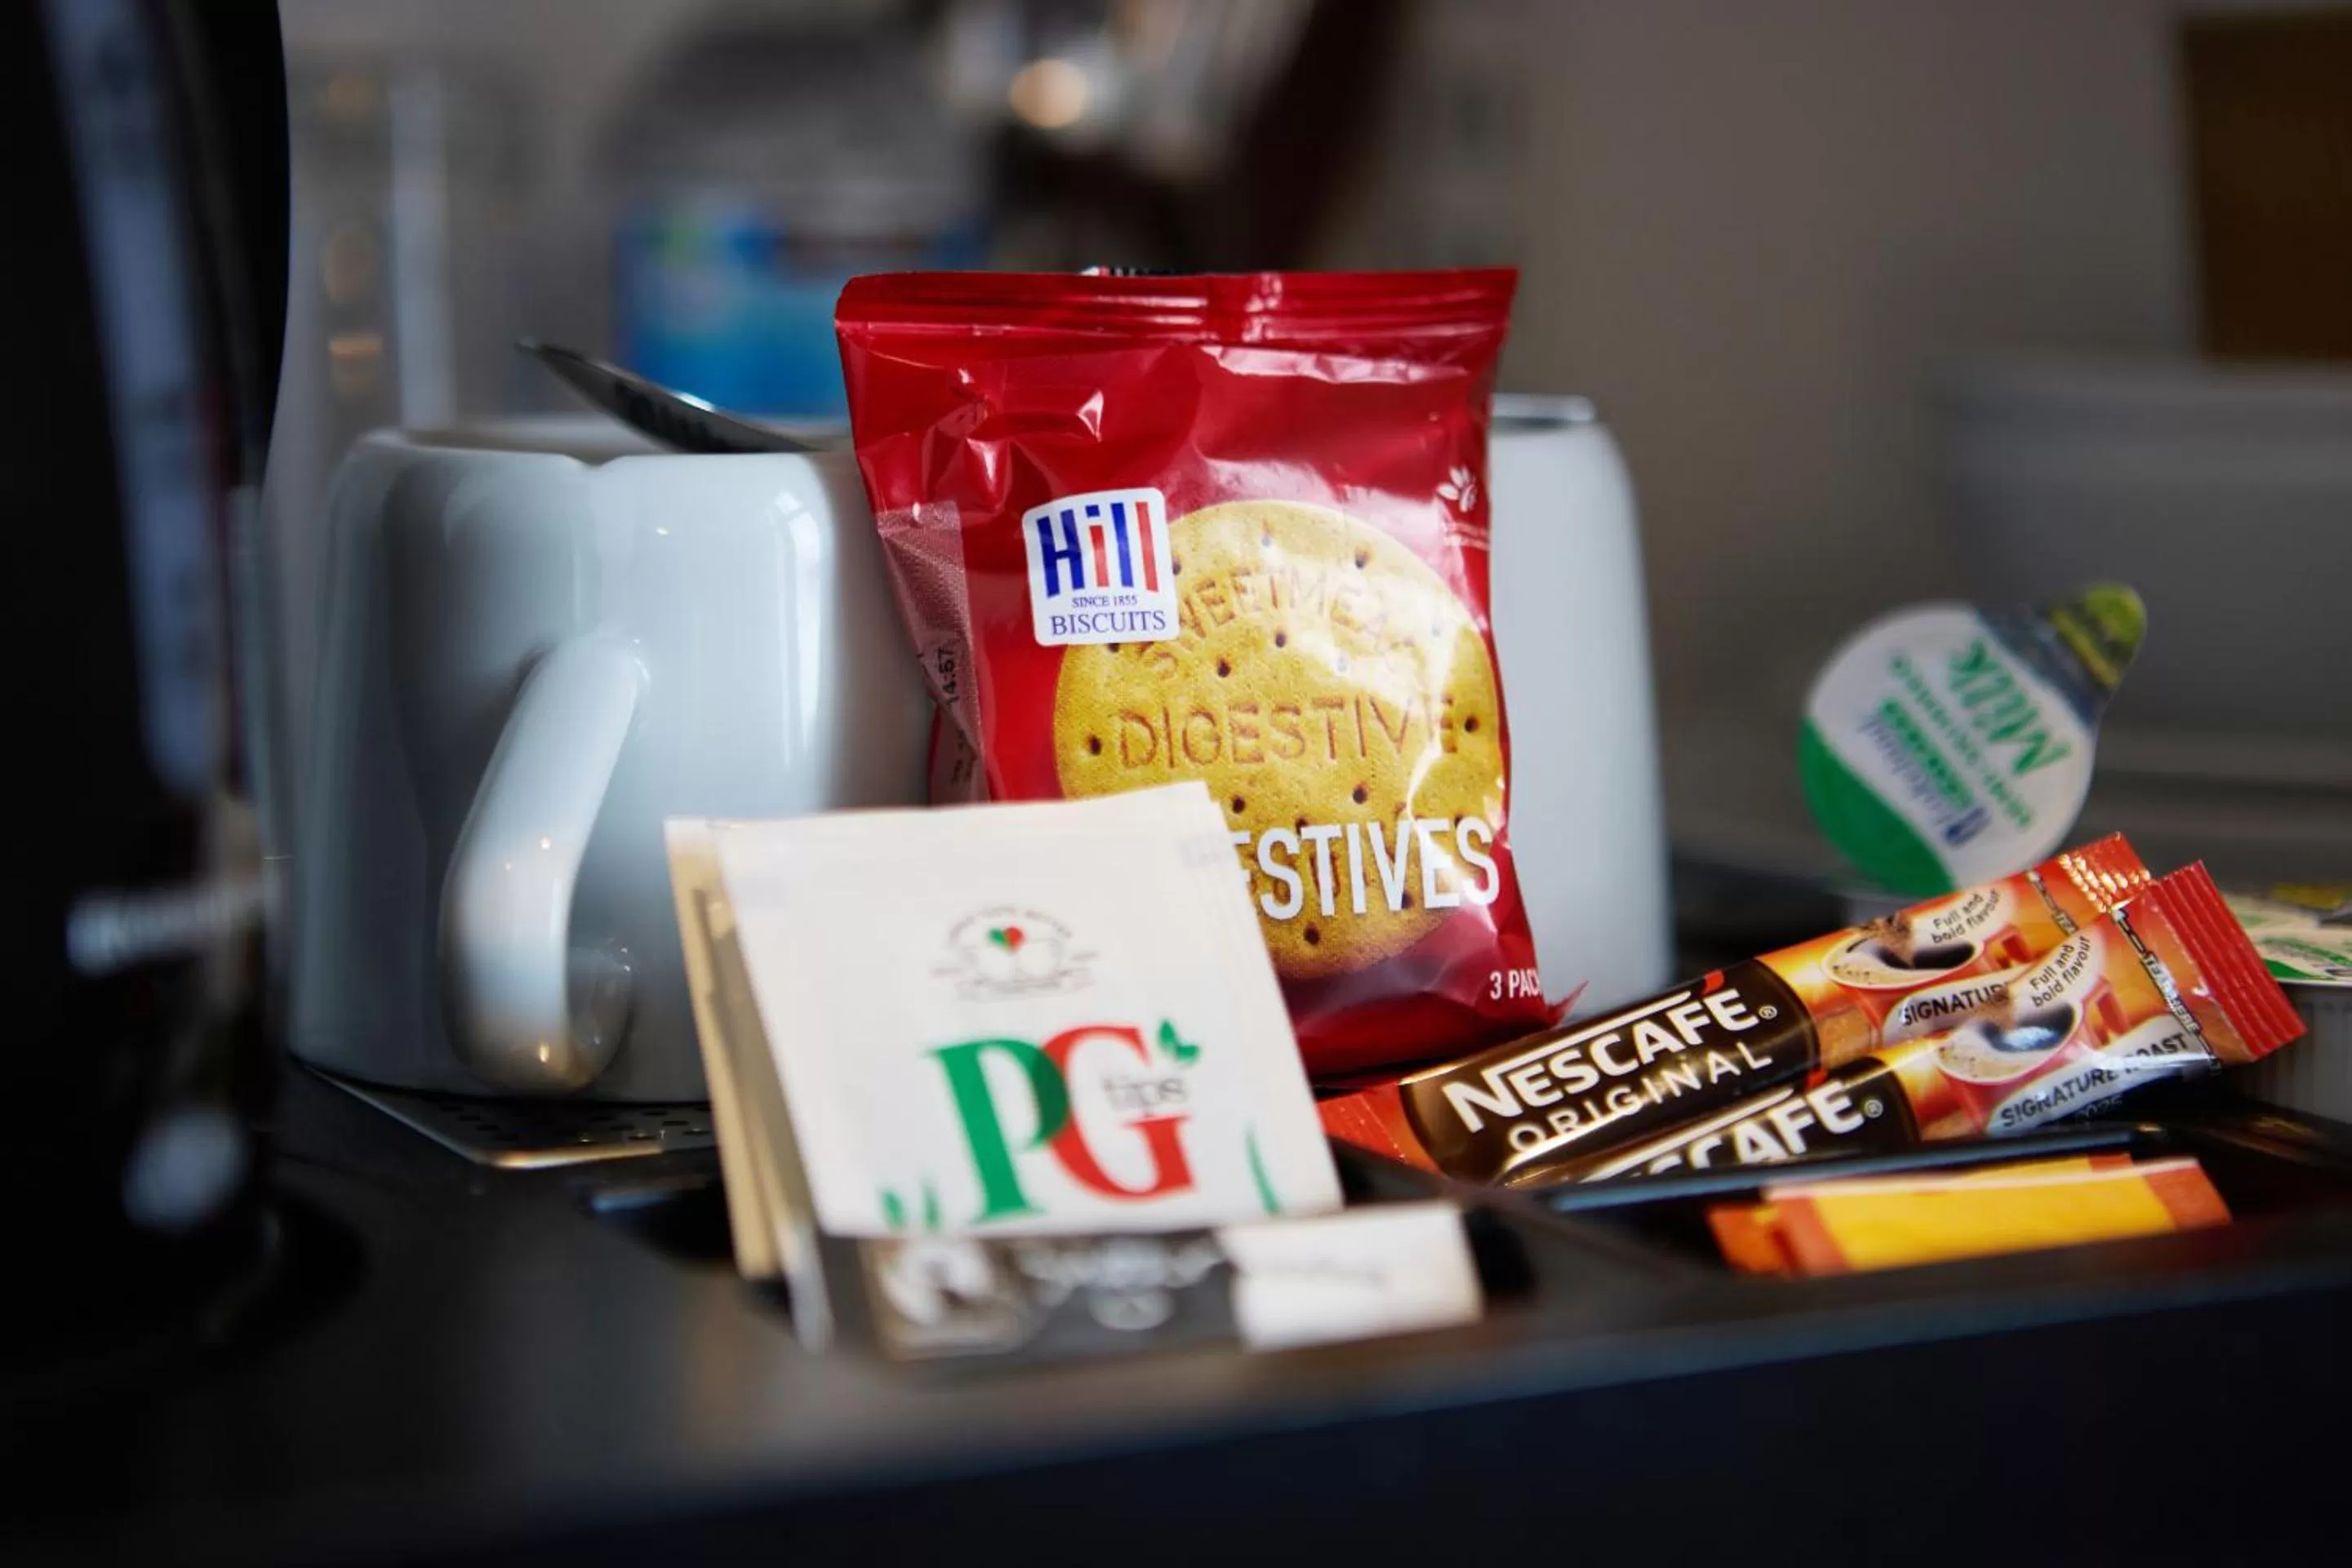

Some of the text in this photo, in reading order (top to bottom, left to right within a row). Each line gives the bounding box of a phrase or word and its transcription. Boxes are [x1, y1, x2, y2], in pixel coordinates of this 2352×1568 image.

[1036, 501, 1160, 598] Hill
[1050, 610, 1167, 636] BISCUITS
[1072, 594, 1138, 608] SINCE 1855
[1117, 694, 1458, 770] DIGESTIVE
[1931, 888, 2001, 944] bold flavour
[1933, 894, 1984, 931] Full and
[1489, 969, 1542, 1000] 3 PAC
[2030, 944, 2075, 990] Full and
[2031, 983, 2065, 1007] bold
[2061, 935, 2091, 987] flavour
[924, 1021, 1198, 1221] PG
[1507, 1042, 1774, 1154] ORIGINAL
[2000, 1067, 2120, 1129] SIGNATURE
